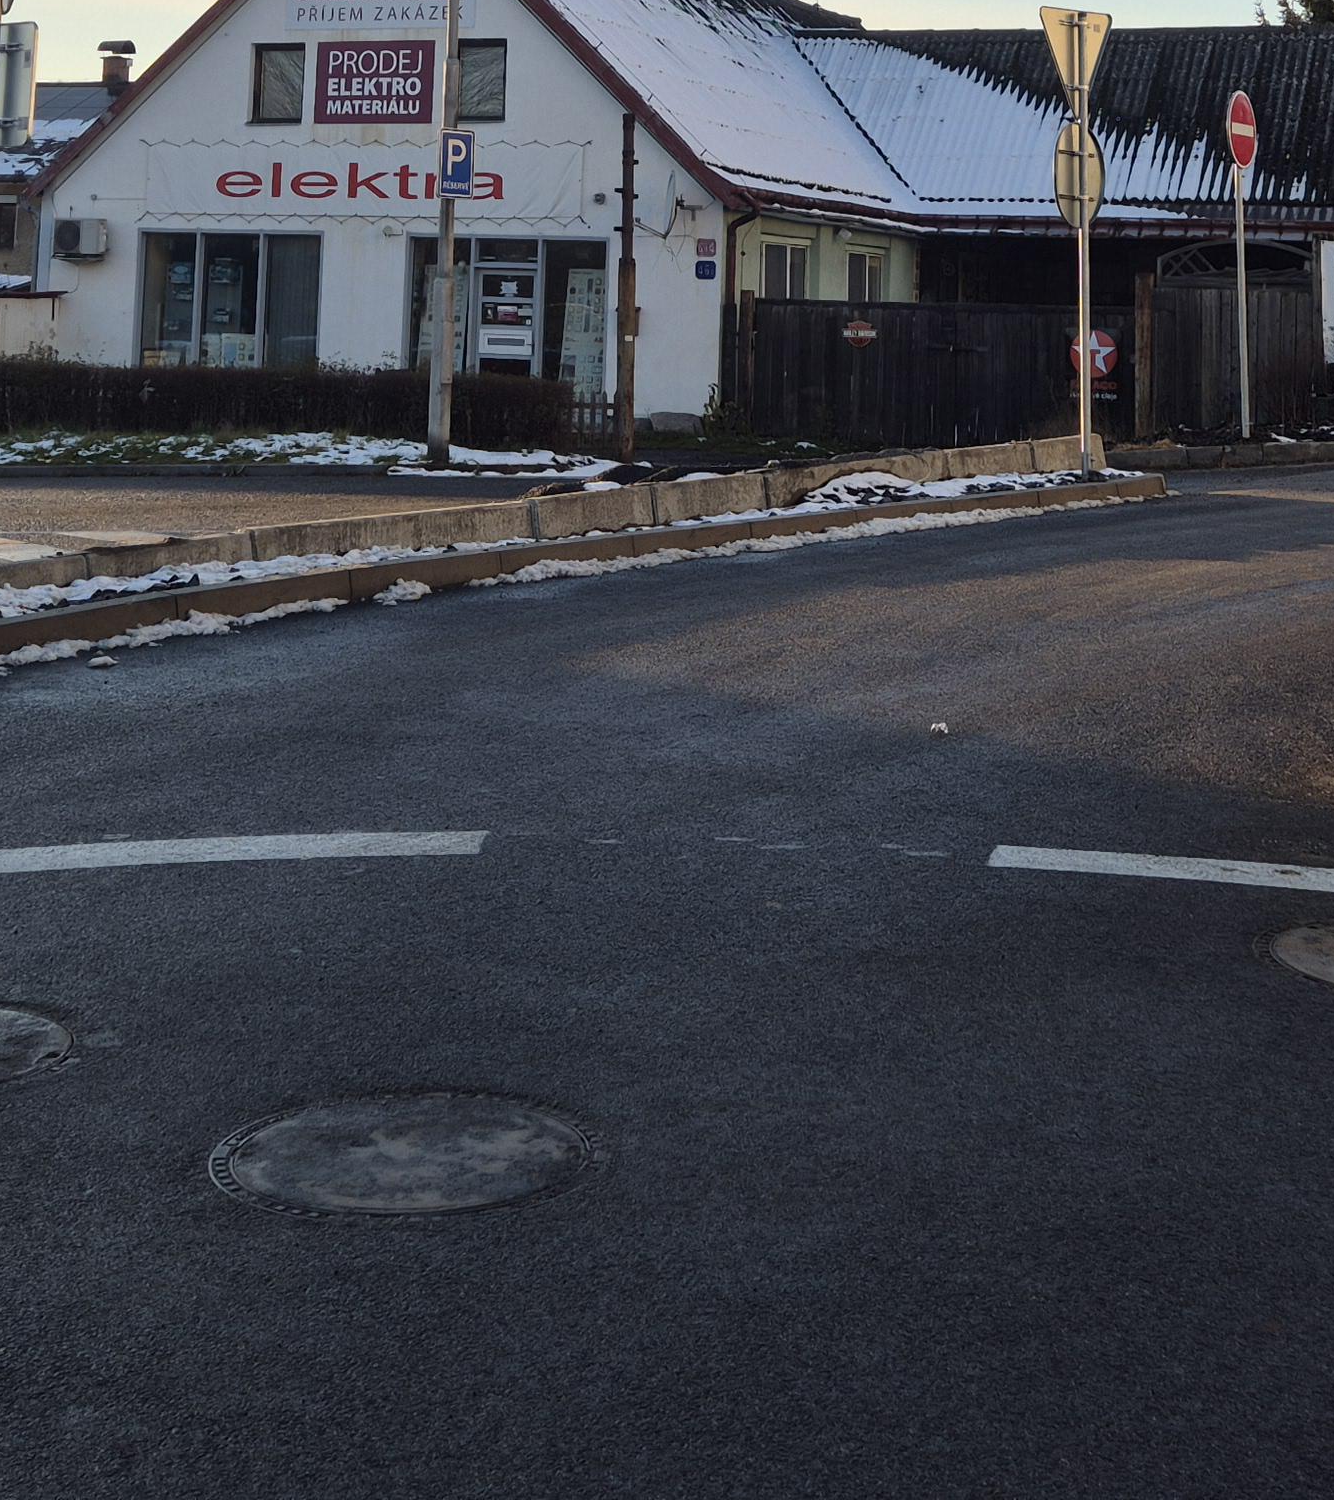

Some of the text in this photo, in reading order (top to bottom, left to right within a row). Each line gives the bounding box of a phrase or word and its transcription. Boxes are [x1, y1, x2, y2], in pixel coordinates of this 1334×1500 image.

[297, 4, 363, 21] PŘÍJEM
[328, 49, 423, 75] PRODEJ
[327, 77, 422, 96] ELEKTRO
[326, 97, 420, 115] MATERIÁLU
[447, 138, 467, 176] P
